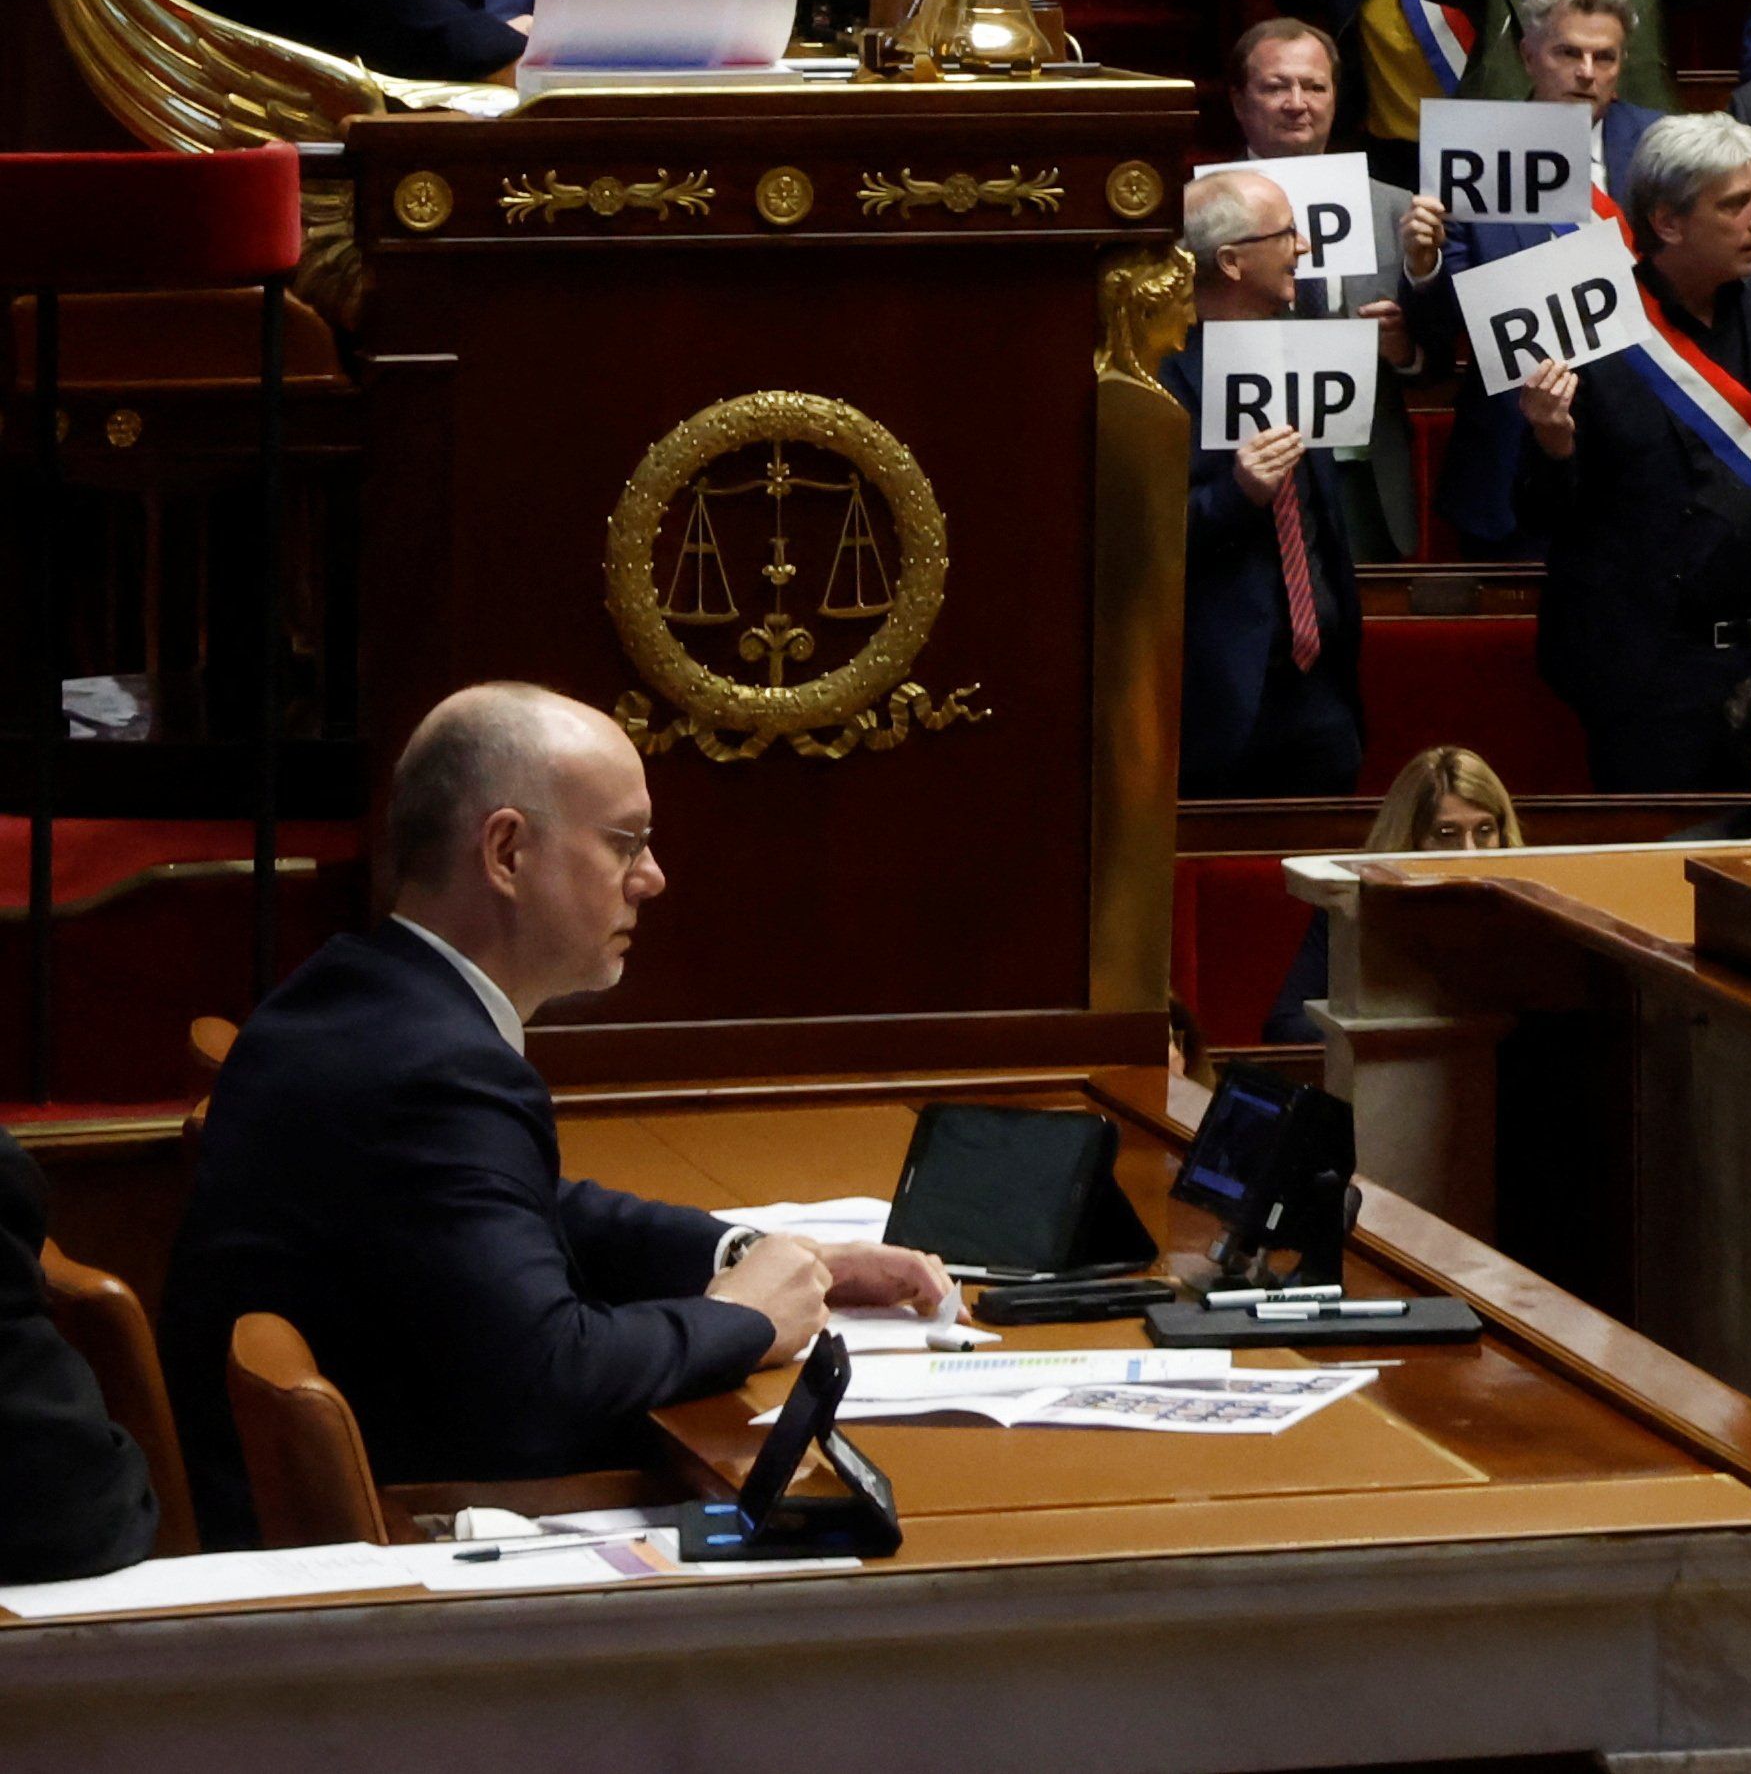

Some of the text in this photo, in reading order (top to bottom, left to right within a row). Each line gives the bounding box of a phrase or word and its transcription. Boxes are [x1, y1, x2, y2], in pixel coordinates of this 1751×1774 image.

[1440, 148, 1571, 215] RIP
[1490, 278, 1617, 381] RIP
[1225, 371, 1355, 441] RIP
